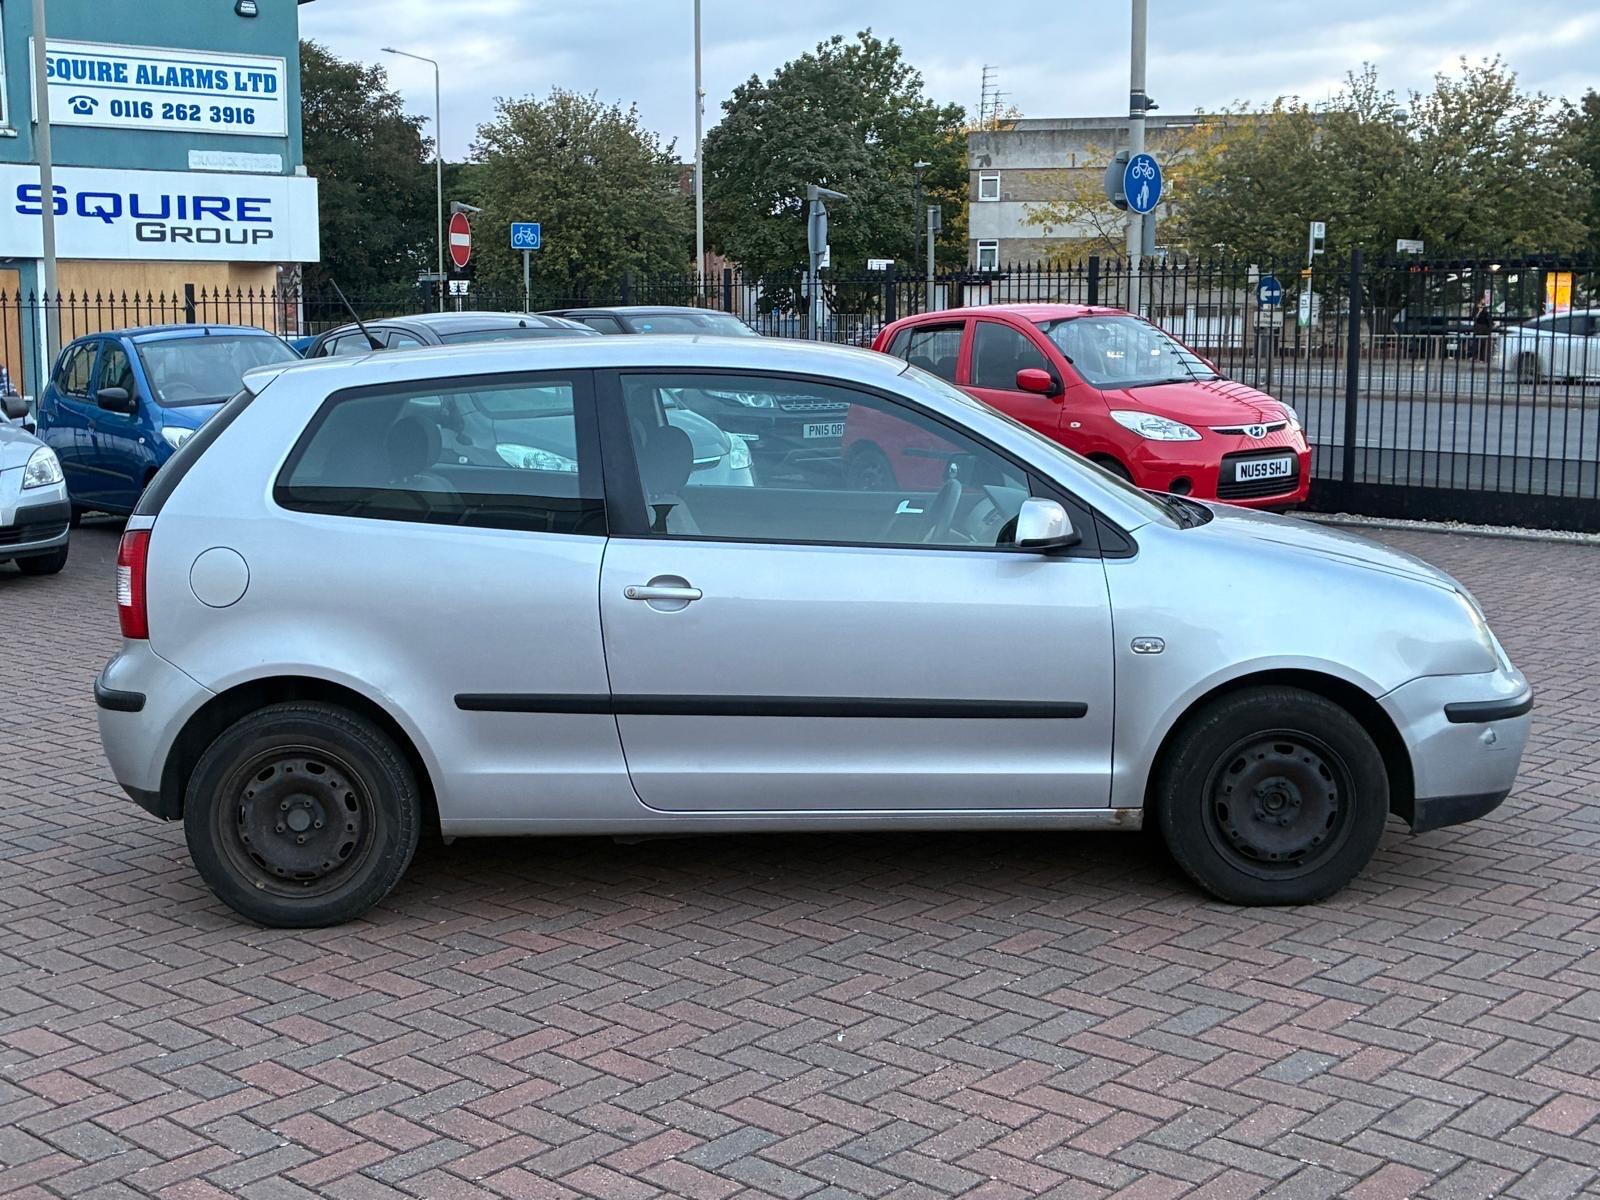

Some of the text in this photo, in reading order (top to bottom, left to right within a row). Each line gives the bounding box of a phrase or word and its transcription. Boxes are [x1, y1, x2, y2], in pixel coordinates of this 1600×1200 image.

[46, 57, 277, 93] SQUIRE ALARMS LTD
[110, 99, 255, 125] 0116 262 3916
[15, 183, 273, 224] SQUIRE
[809, 424, 829, 436] PN15
[1240, 460, 1288, 479] NU59 SHJ
